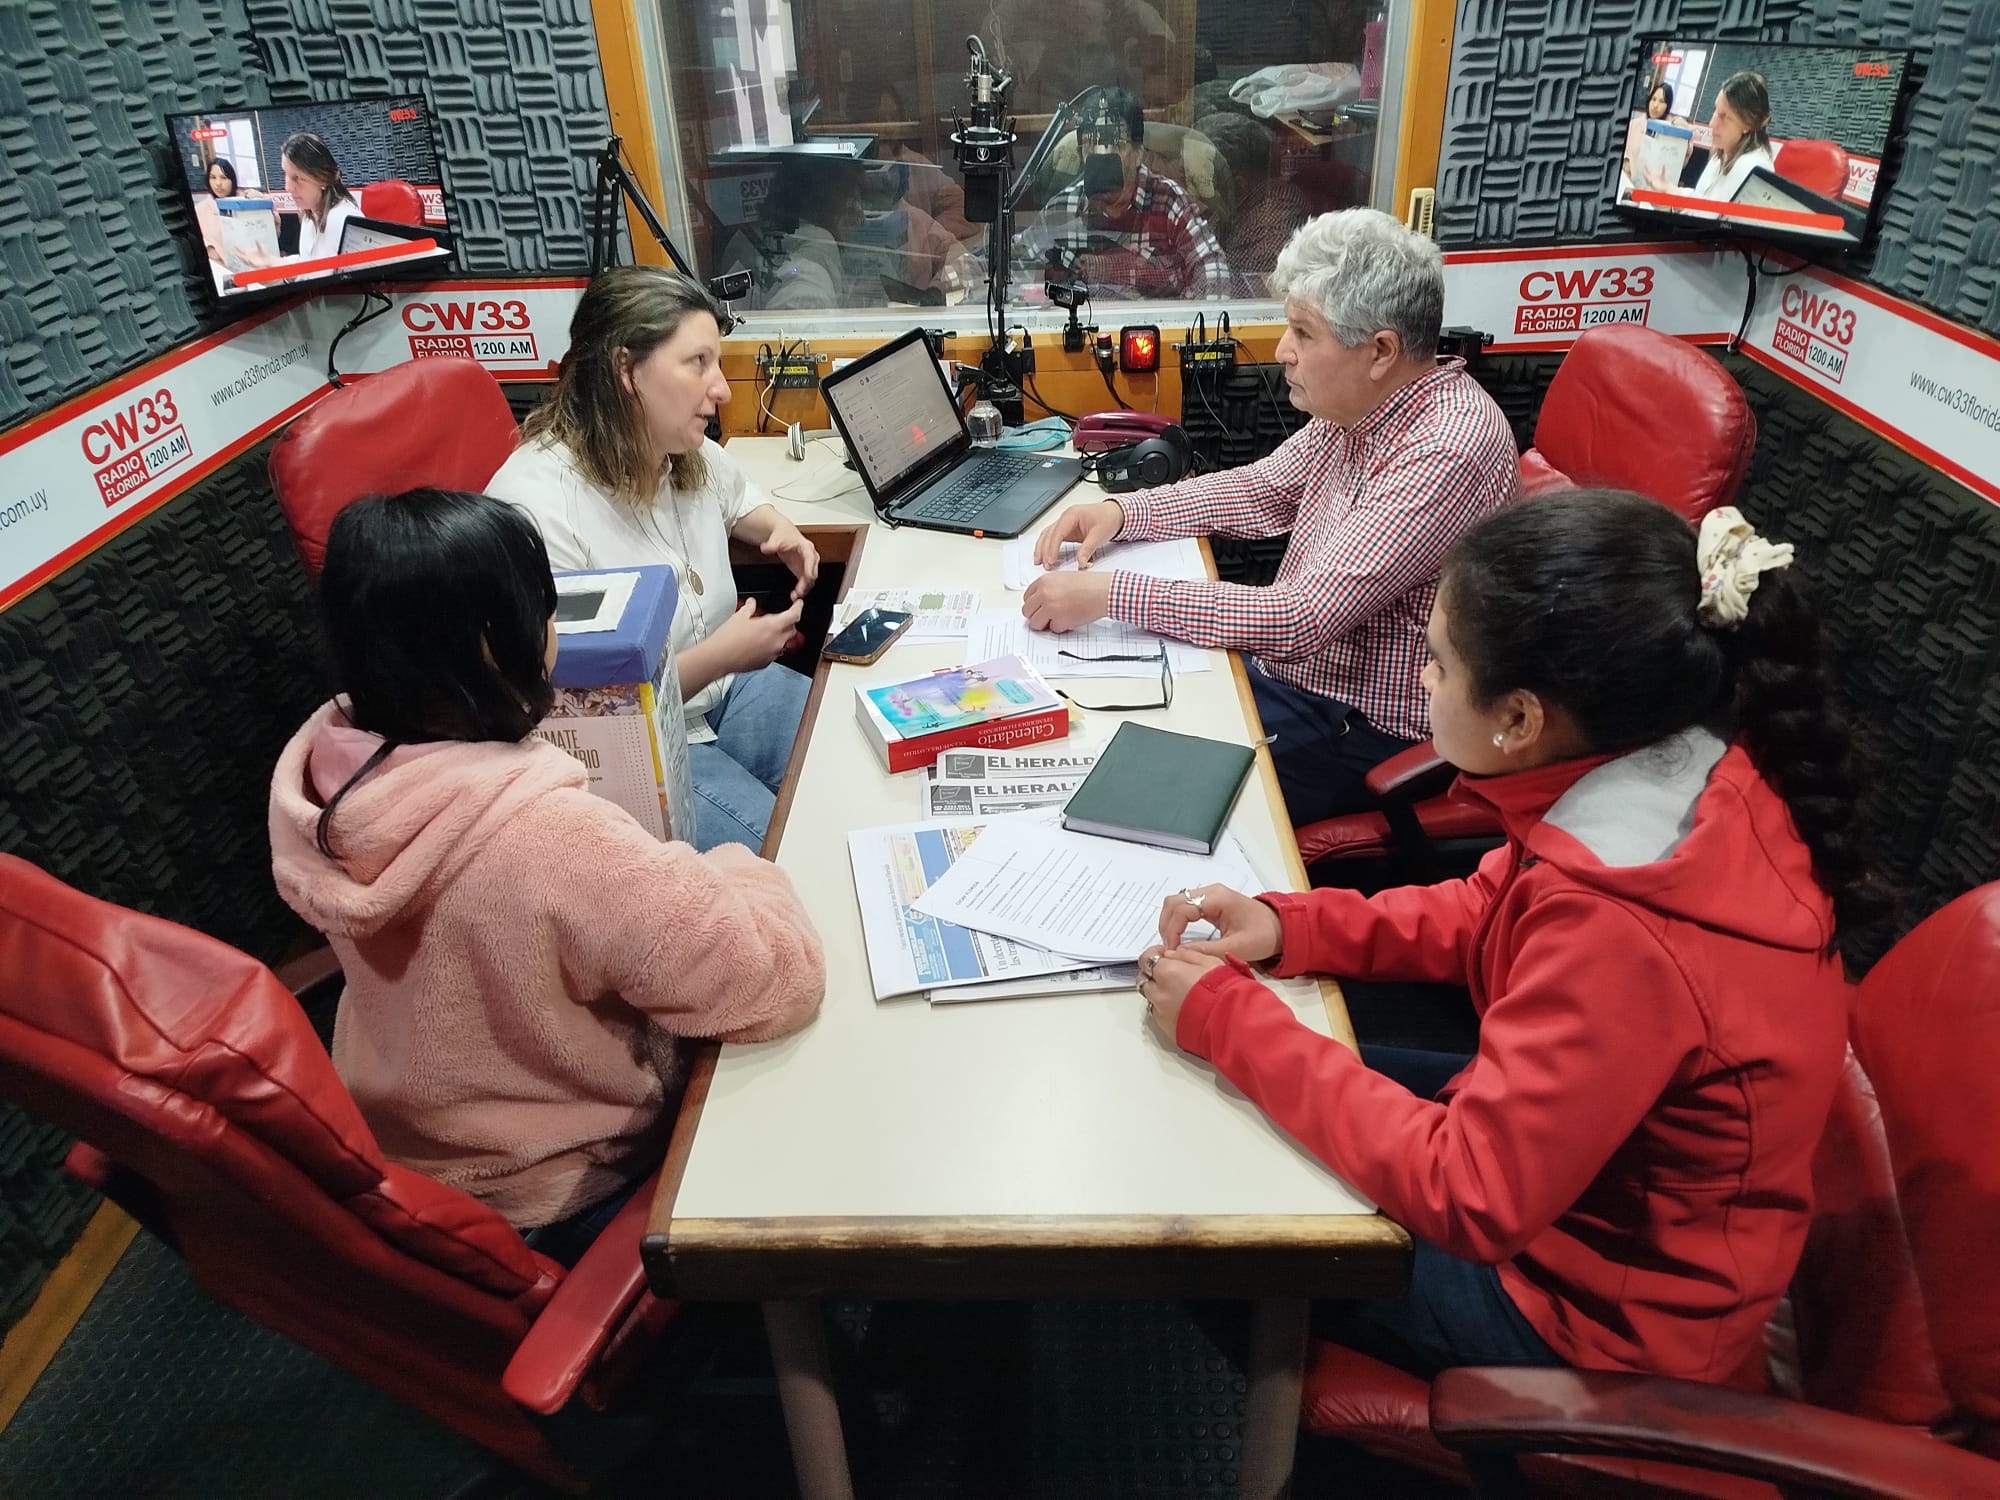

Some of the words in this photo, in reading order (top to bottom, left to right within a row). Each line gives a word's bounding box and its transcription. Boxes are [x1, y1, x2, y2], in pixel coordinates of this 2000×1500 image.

[1520, 266, 1655, 301] CW33
[402, 301, 531, 332] CW33
[1520, 319, 1576, 332] FLORIDA
[1522, 306, 1577, 320] RADIO
[1583, 310, 1616, 324] 1200
[1619, 308, 1643, 323] AM
[1782, 284, 1857, 345] CW33
[414, 338, 467, 350] RADIO
[1776, 335, 1804, 359] FLORIDA
[1778, 323, 1807, 346] RADIO
[474, 341, 505, 355] 1200
[510, 341, 532, 354] AM
[1808, 344, 1826, 366] 1200
[1827, 356, 1843, 375] AM
[210, 343, 311, 407] www.cw33florida.com.uy
[81, 388, 178, 465] CW33
[145, 448, 169, 471] 1200
[170, 435, 187, 457] AM
[99, 455, 140, 487] RADIO
[105, 470, 148, 502] FLORIDA
[978, 723, 1054, 748] Calendario
[987, 756, 1011, 768] EL
[974, 785, 999, 795] EL
[1003, 782, 1076, 794] HERAL
